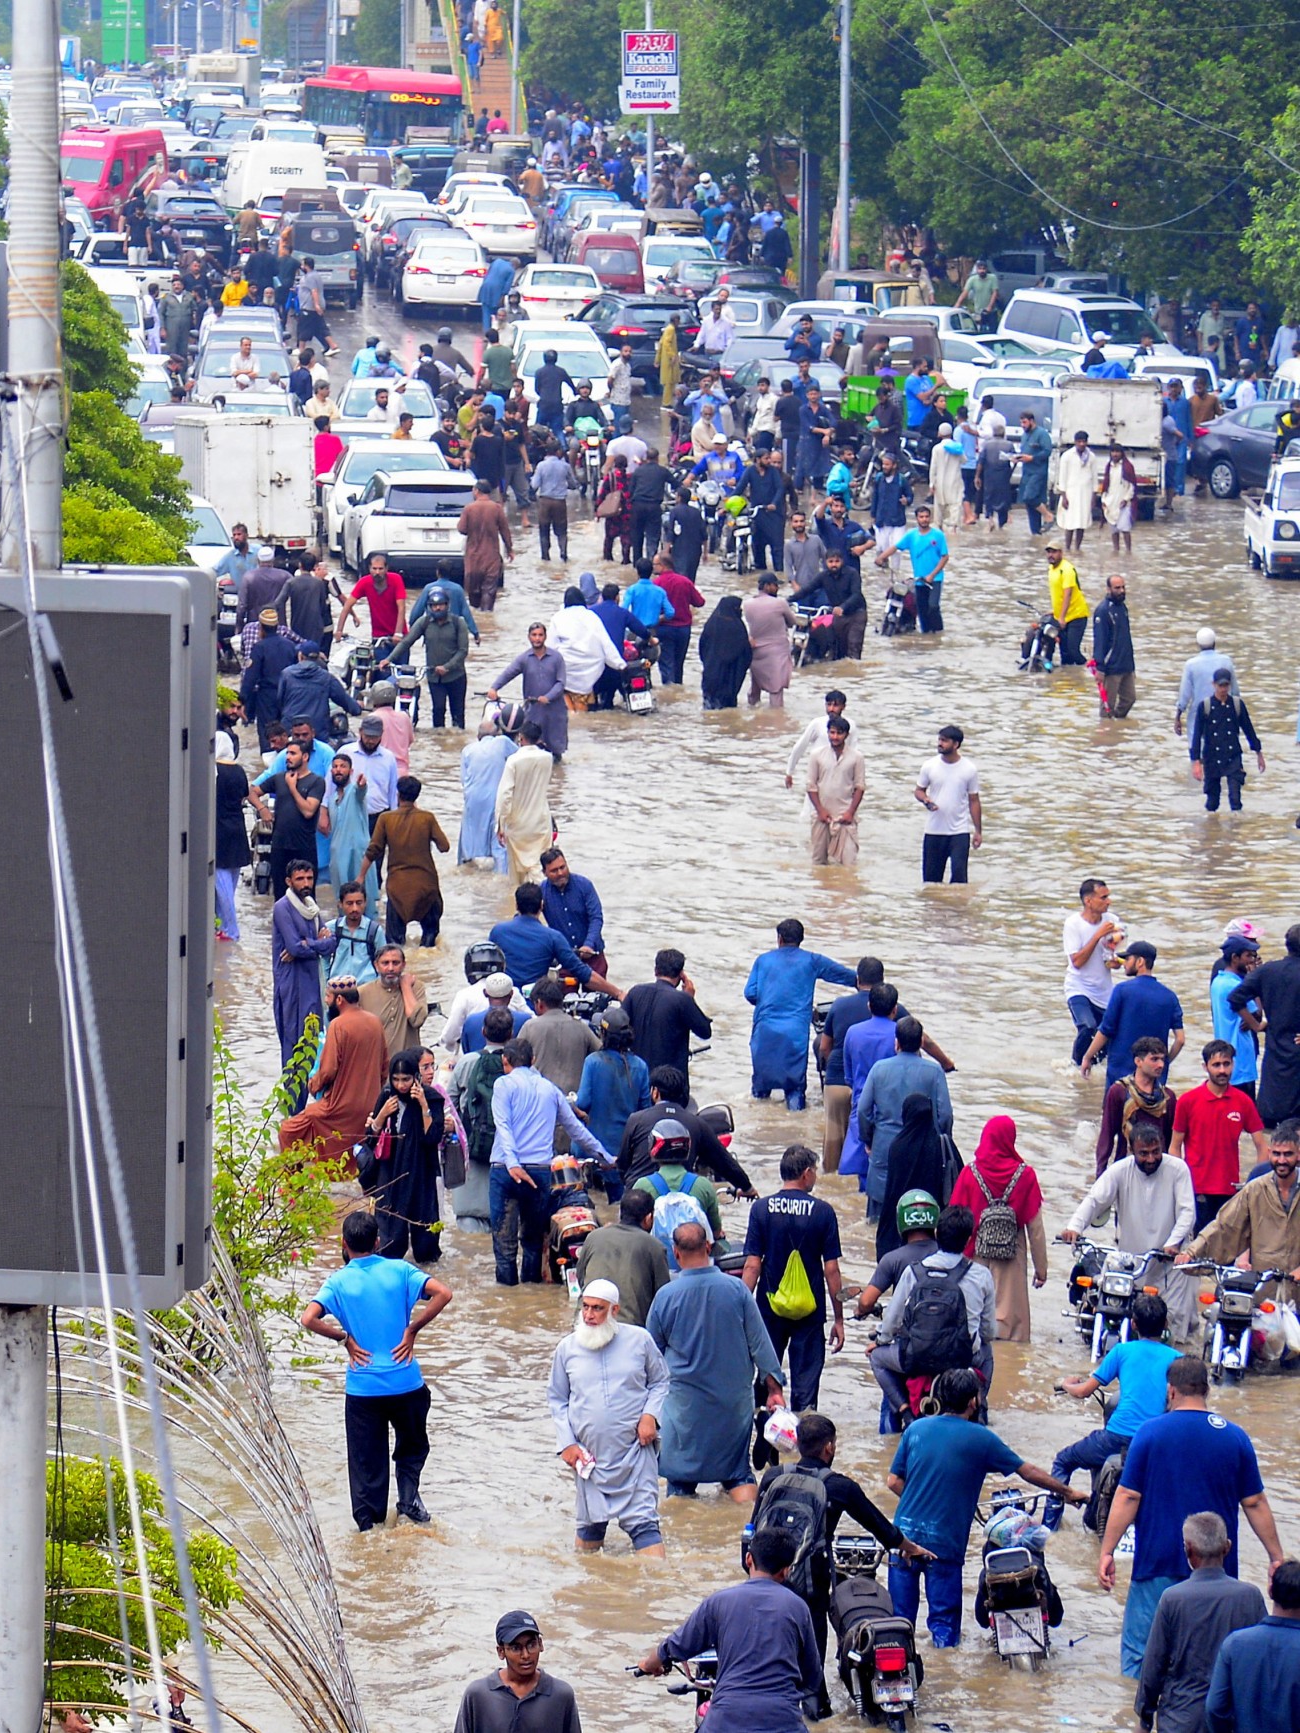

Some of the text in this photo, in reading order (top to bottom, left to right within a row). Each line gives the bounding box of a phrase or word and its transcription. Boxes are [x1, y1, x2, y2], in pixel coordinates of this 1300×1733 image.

[628, 53, 673, 64] Karachi
[635, 79, 667, 90] Family
[626, 90, 676, 99] Restaurant
[269, 166, 303, 175] SECURITY
[768, 1197, 814, 1216] SECURITY
